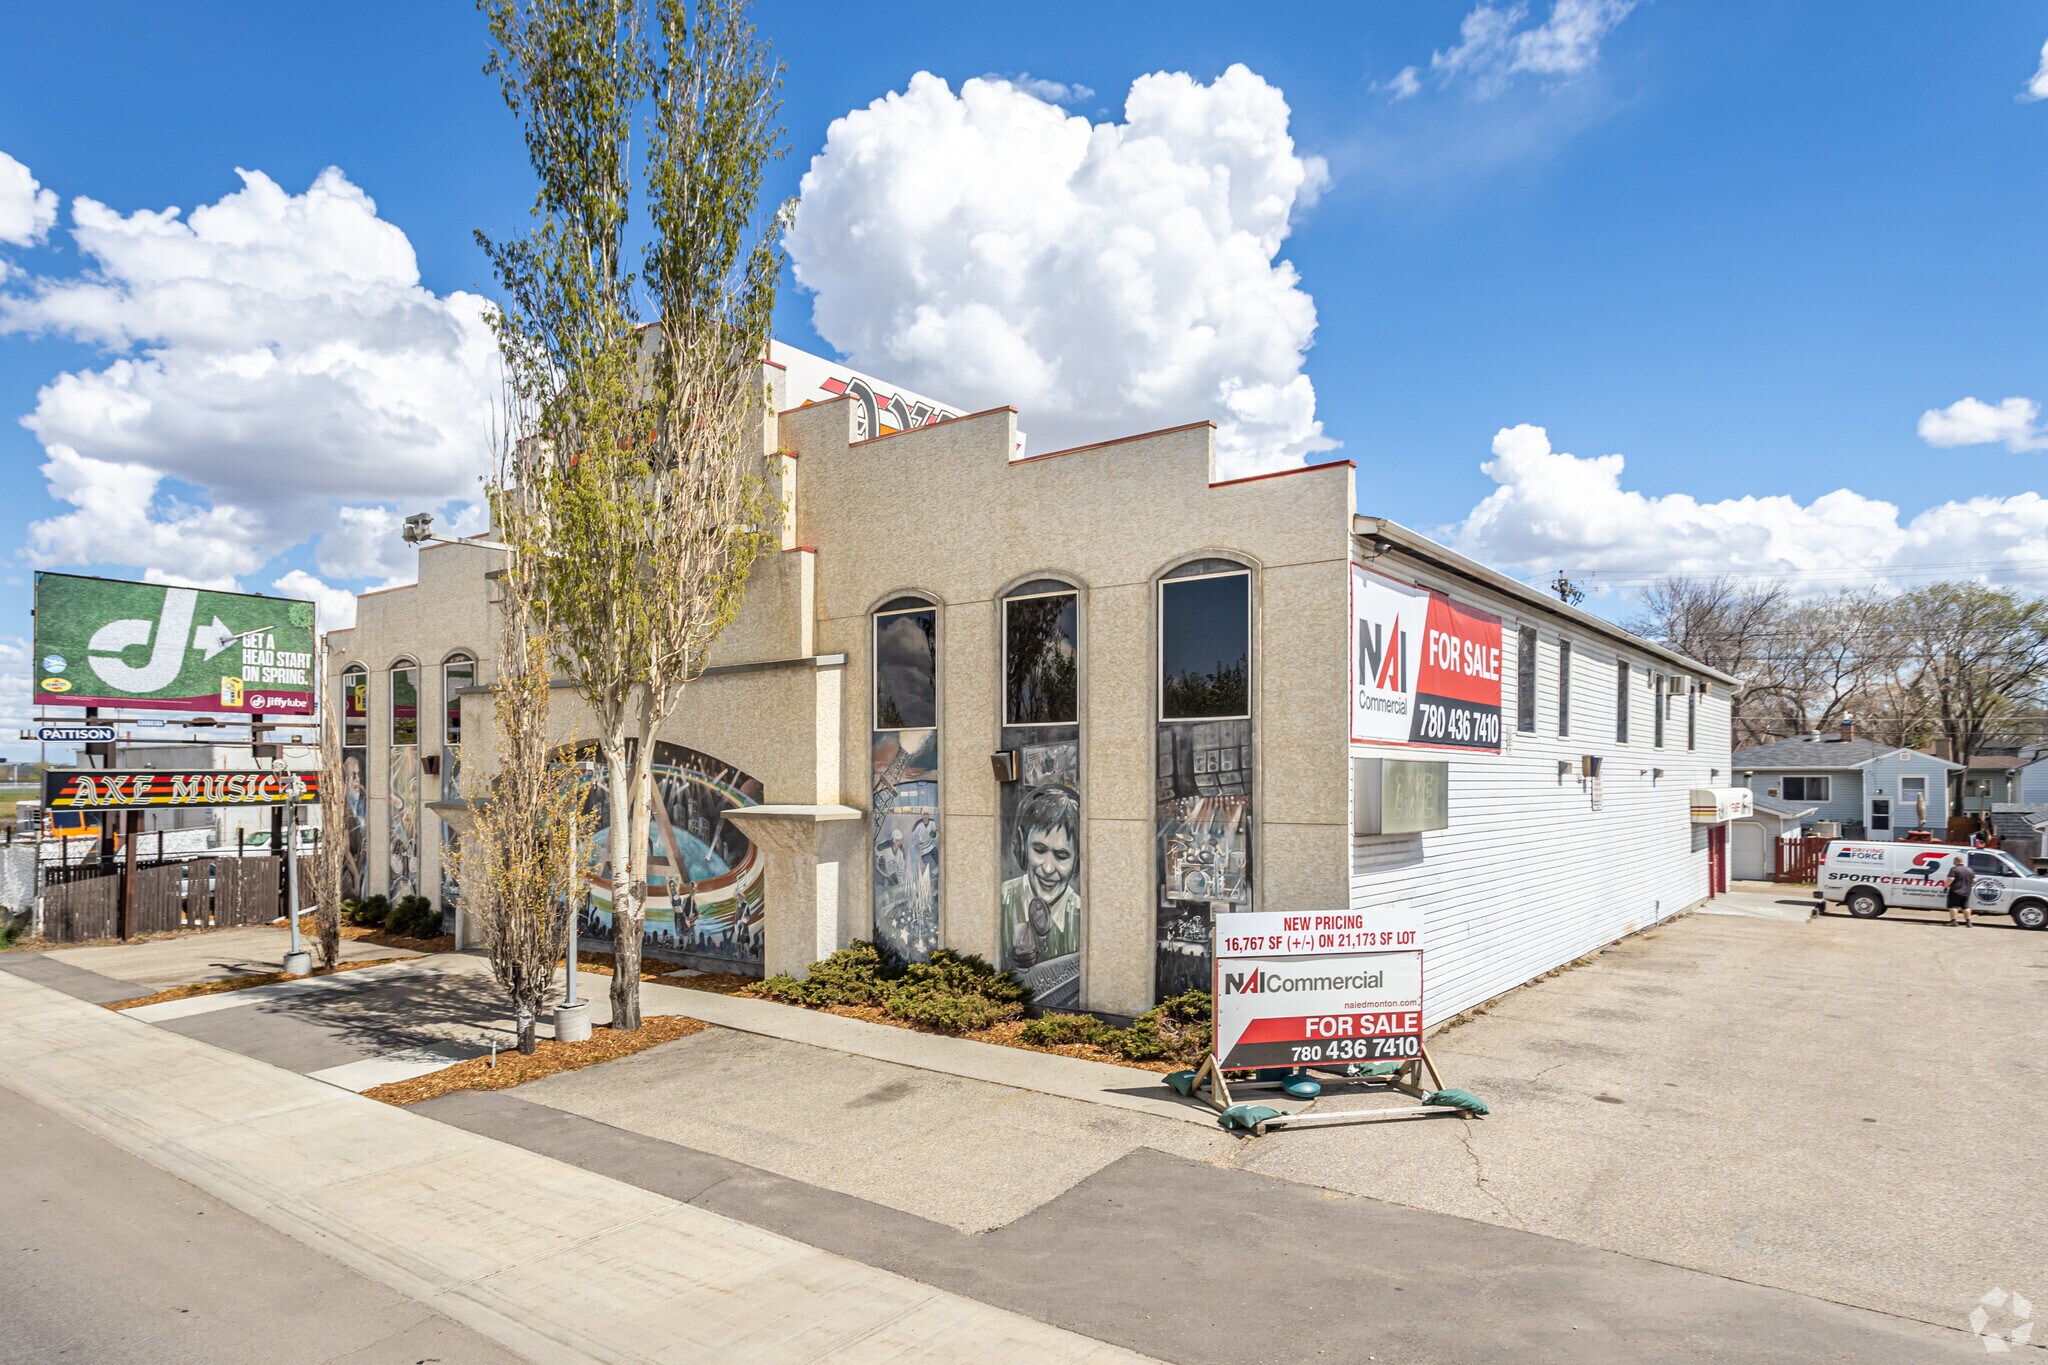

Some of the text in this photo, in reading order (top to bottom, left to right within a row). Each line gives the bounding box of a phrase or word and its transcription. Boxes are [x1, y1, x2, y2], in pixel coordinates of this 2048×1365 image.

[242, 632, 275, 649] GET A
[242, 648, 312, 669] HEAD START
[1359, 611, 1407, 694] NAI
[1429, 629, 1499, 681] FOR SALE
[242, 665, 308, 685] ON SPRING.
[1359, 689, 1408, 715] Commercial
[42, 728, 112, 740] PATTISON
[1419, 703, 1445, 739] 780
[1448, 708, 1470, 741] 436
[1473, 712, 1498, 744] 7410
[70, 774, 275, 807] AXE MUSIC
[1852, 852, 1884, 860] FORCE
[1828, 872, 1947, 887] SPORTCENTRA
[1283, 915, 1363, 931] NEW PRICING
[1225, 931, 1416, 953] 16,767 SF (+/-) ON 21,173 SF LOT
[1344, 1000, 1417, 1009] naiedmonton.com
[1305, 1013, 1418, 1038] FOR SALE
[1291, 1036, 1418, 1062] 780 436 7410
